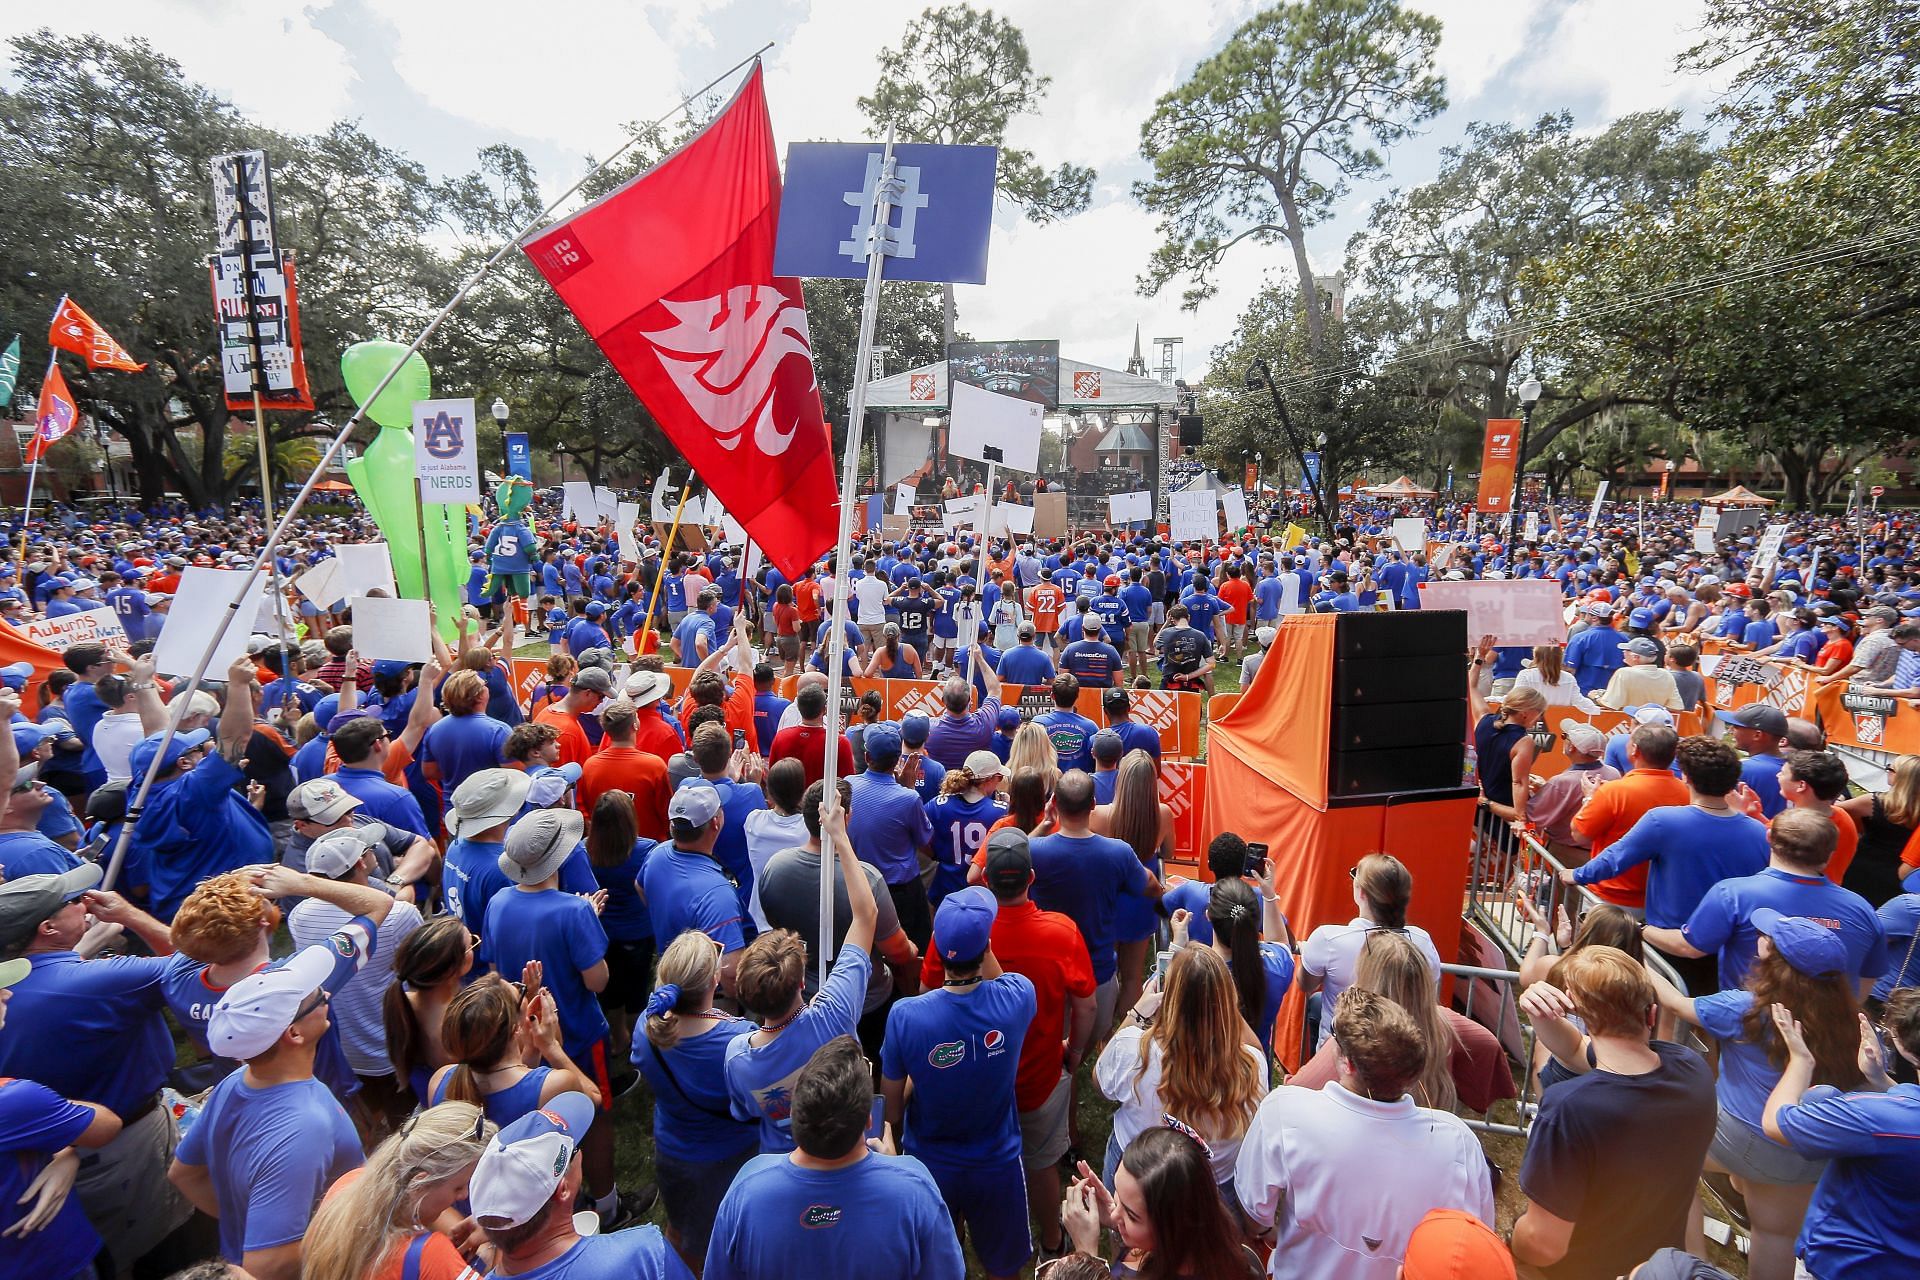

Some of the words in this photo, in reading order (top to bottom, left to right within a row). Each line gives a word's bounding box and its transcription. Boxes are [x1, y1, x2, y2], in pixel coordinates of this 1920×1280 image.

[1492, 434, 1511, 447] #7
[427, 464, 438, 472] just
[431, 476, 472, 489] NERDS
[1488, 496, 1501, 505] UF
[670, 583, 678, 595] 1
[1061, 578, 1074, 594] 15
[114, 595, 131, 615] 15
[1038, 596, 1056, 613] 22
[901, 611, 922, 629] 12
[1100, 613, 1117, 625] 11
[521, 668, 543, 692] THE
[894, 687, 923, 713] THE
[1844, 695, 1894, 711] GAMEDAY
[951, 821, 987, 865] 19
[987, 1048, 1006, 1059] pepsi
